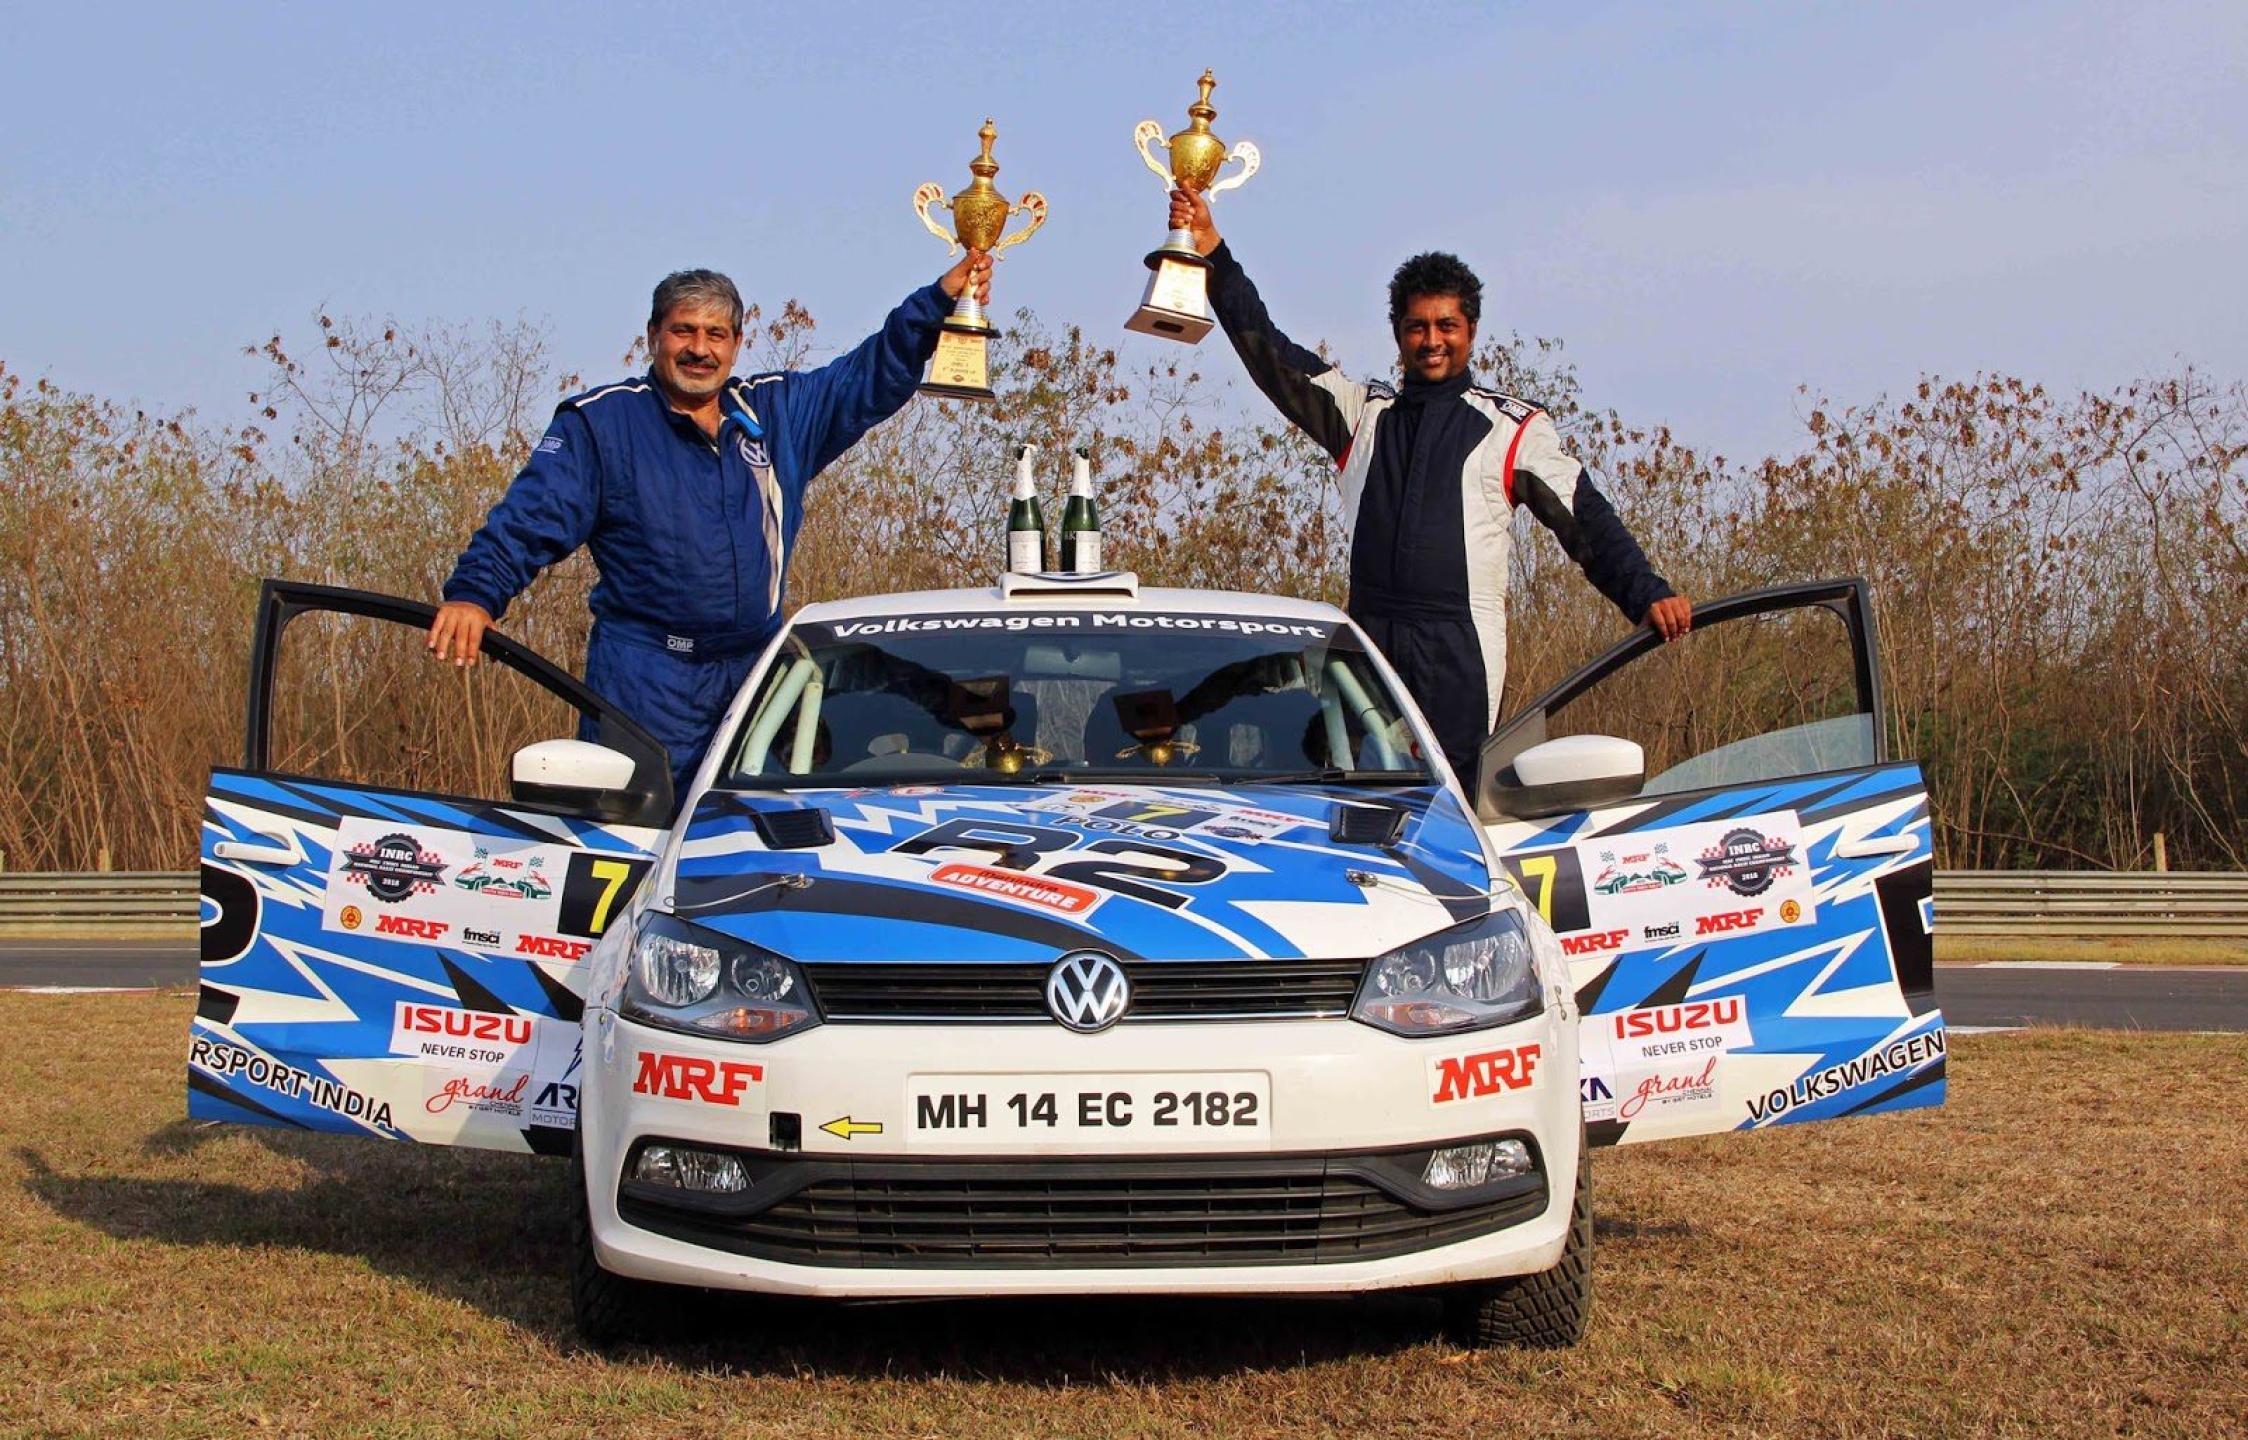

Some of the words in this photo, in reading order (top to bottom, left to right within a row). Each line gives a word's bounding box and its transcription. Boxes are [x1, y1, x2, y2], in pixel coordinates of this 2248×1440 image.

[834, 613, 1080, 639] Volkswagen
[1092, 613, 1327, 639] Motorsport
[1127, 803, 1192, 822] 7
[1050, 816, 1181, 842] POLO
[380, 848, 414, 861] INRC
[493, 858, 523, 869] MRF
[1728, 842, 1760, 855] INRC
[590, 860, 631, 933] 7
[942, 872, 1080, 908] ADVENTURE
[1520, 854, 1557, 927] 7
[375, 914, 449, 940] MRF
[1696, 908, 1764, 935] MRF
[516, 934, 592, 960] MRF
[1560, 929, 1629, 955] MRF
[403, 1006, 531, 1045] ISUZU
[1615, 999, 1738, 1039] ISUZU
[421, 1042, 466, 1060] NEVER
[469, 1046, 504, 1063] STOP
[1642, 1040, 1685, 1057] NEVER
[1689, 1036, 1723, 1053] STOP
[191, 1039, 308, 1097] RSPORT
[311, 1081, 395, 1130] INDIA
[633, 1052, 763, 1106] MRF
[1433, 1044, 1540, 1103] MRF
[1620, 1055, 1717, 1118] grand
[1746, 1030, 1946, 1123] VOLKSWAGEN
[425, 1075, 529, 1113] grand
[917, 1093, 987, 1129] MH
[1007, 1092, 1058, 1127] 14
[1079, 1092, 1133, 1127] EC
[1153, 1091, 1258, 1126] 2182
